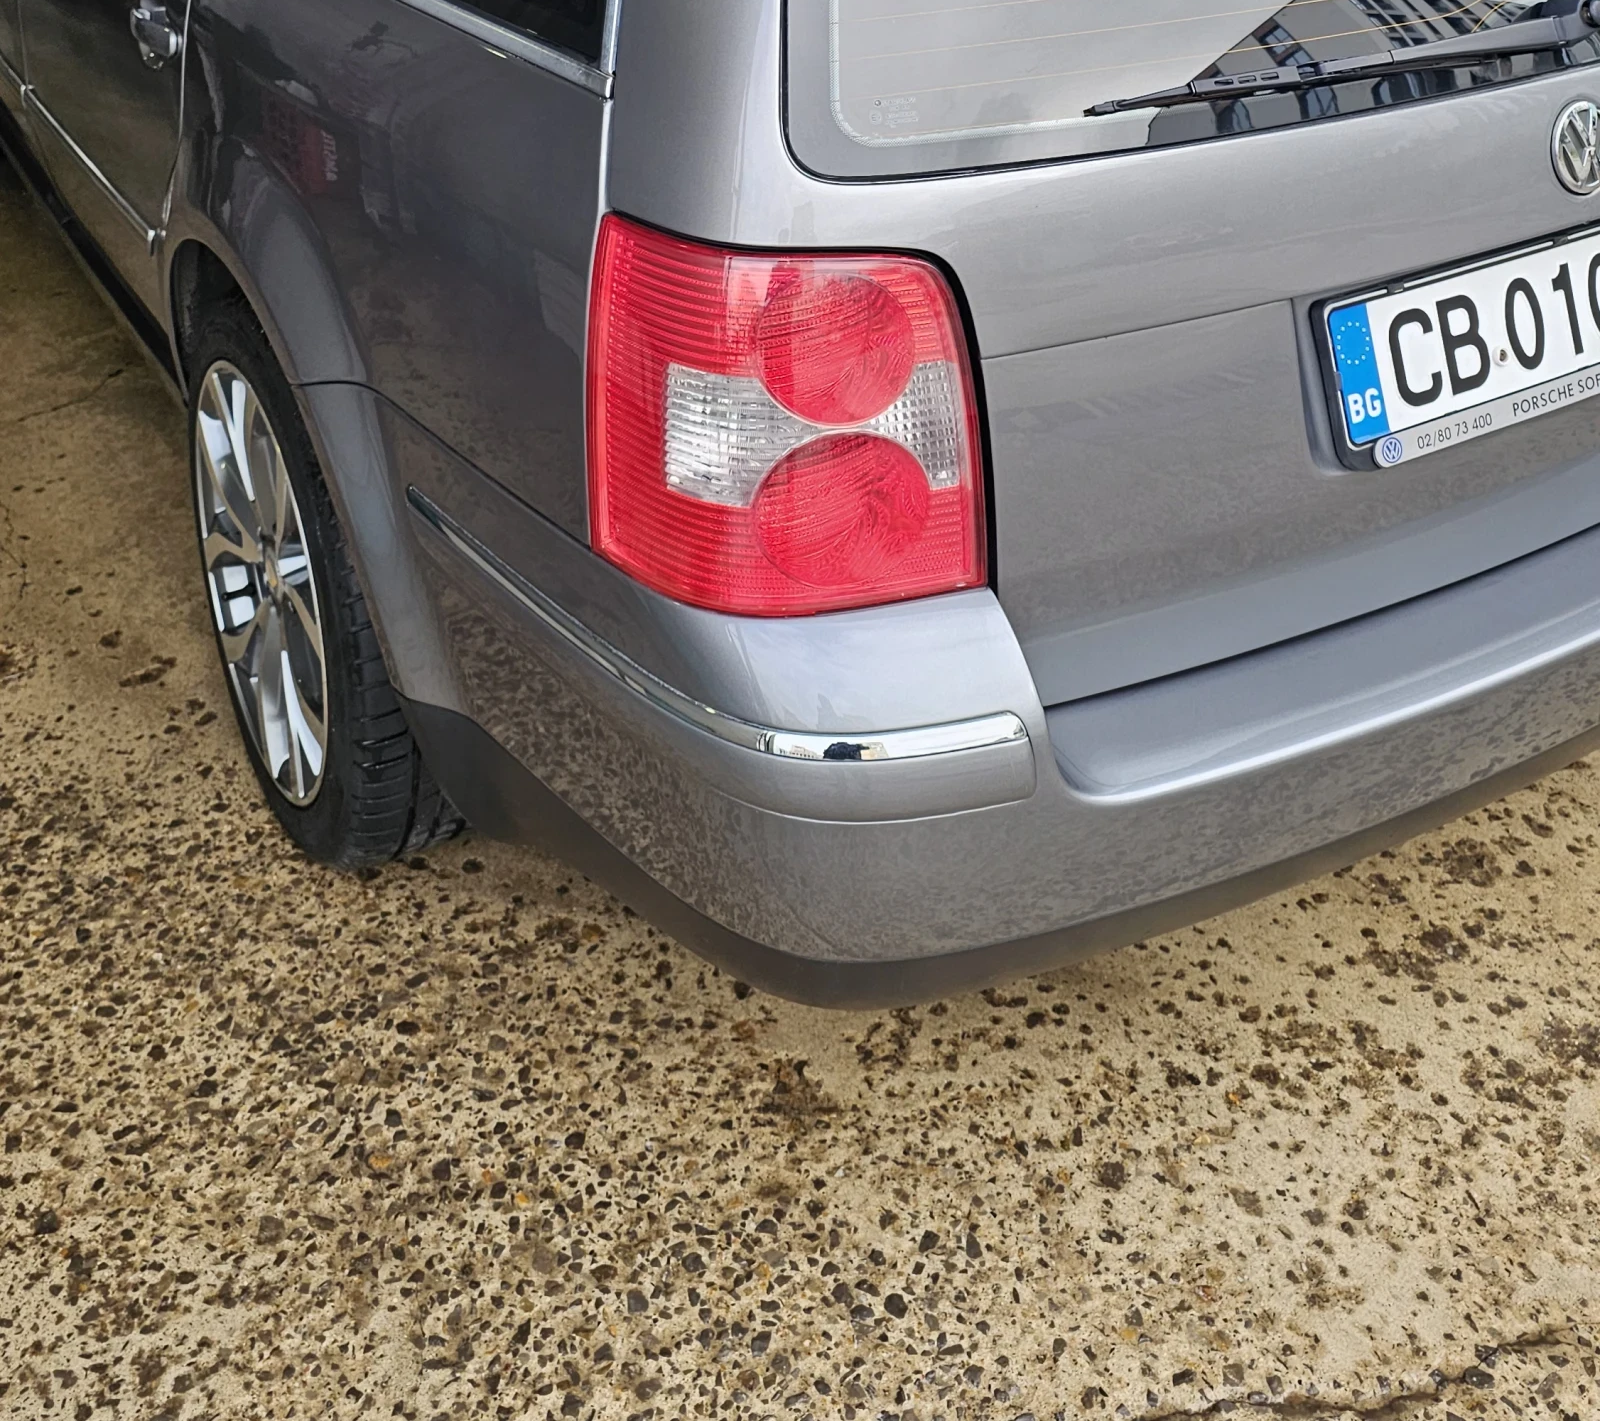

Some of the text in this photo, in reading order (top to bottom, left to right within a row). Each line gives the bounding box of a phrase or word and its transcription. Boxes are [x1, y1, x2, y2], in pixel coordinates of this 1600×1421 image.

[1388, 294, 1491, 407] CB
[1347, 387, 1382, 424] BG
[1416, 426, 1452, 450] 02/80
[1454, 420, 1469, 437] 73
[1472, 412, 1493, 431] 400
[1512, 383, 1575, 417] PORSCHE
[1382, 436, 1403, 464] VW
